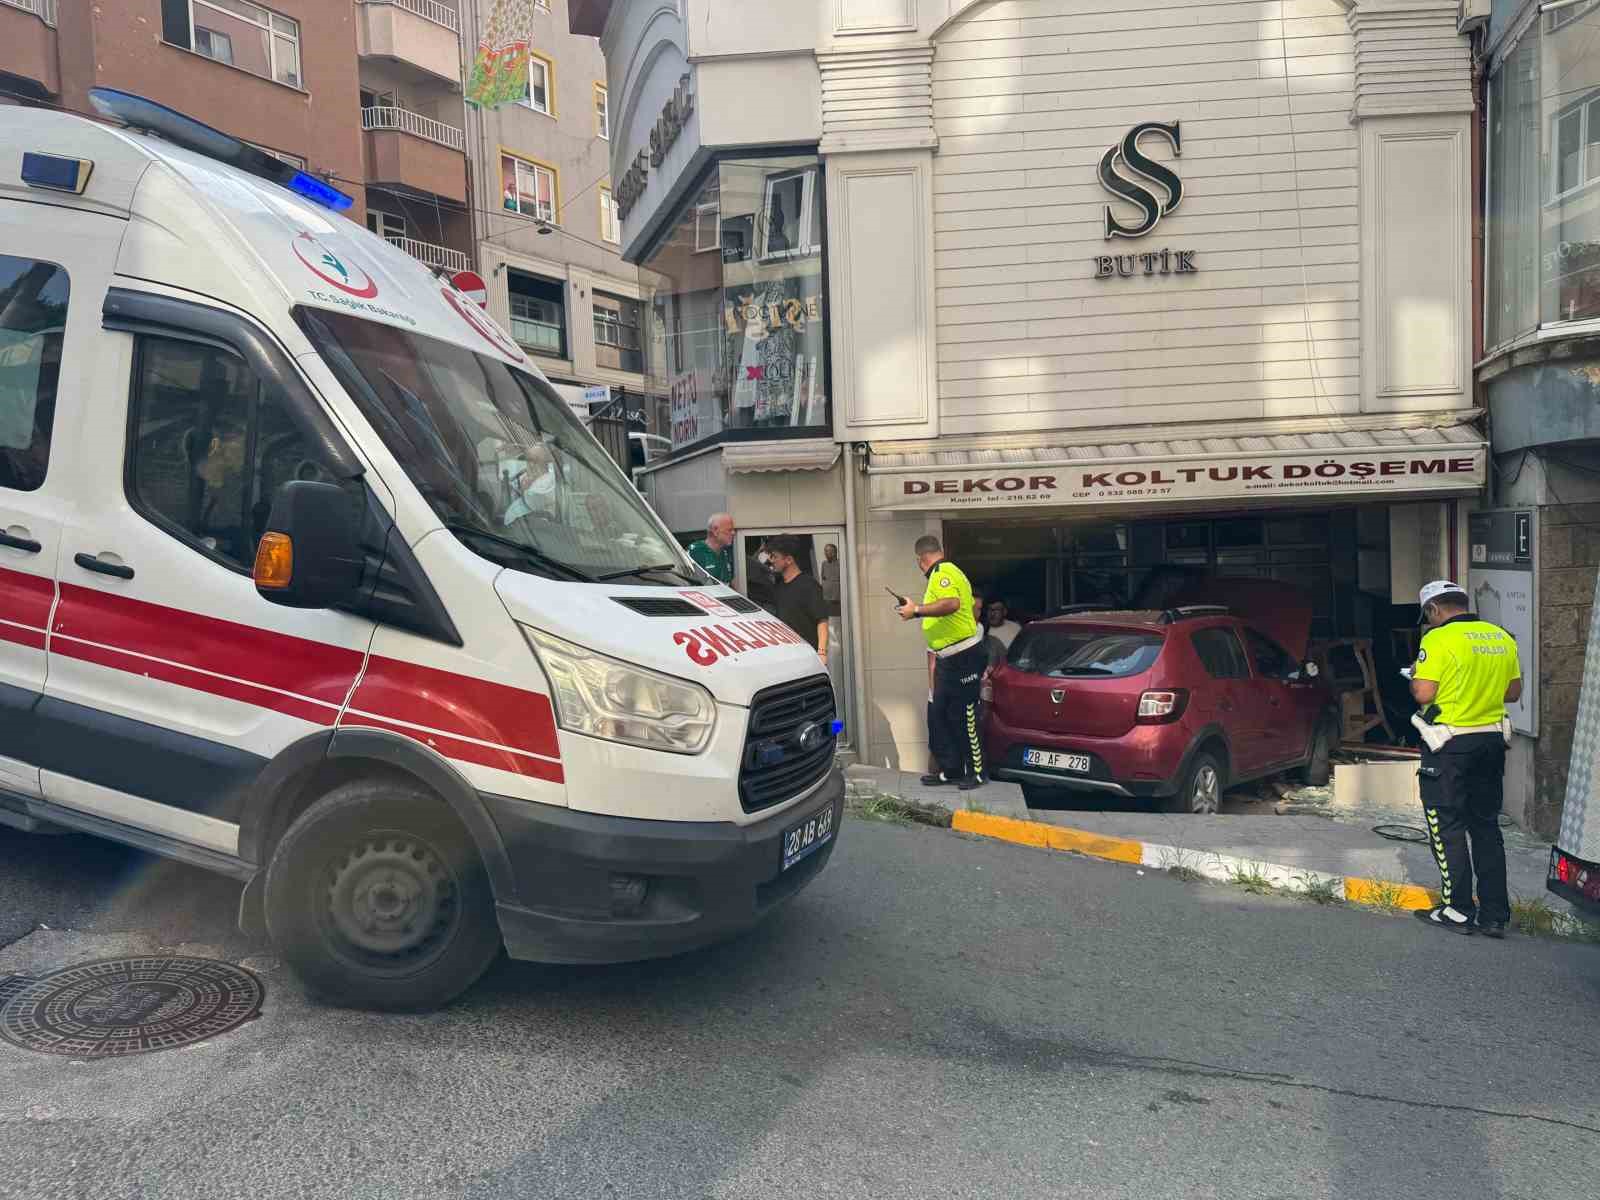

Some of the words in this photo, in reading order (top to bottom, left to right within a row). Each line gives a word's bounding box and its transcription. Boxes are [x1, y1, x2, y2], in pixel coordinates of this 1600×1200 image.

[1095, 249, 1198, 278] BUTİK
[903, 475, 1057, 495] DEKOR
[1082, 464, 1274, 488] KOLTUK
[1282, 457, 1475, 480] DÖŞEME
[1028, 751, 1040, 763] 28
[1047, 753, 1061, 766] AF
[1068, 756, 1088, 770] 278
[787, 828, 801, 857] 28
[801, 820, 816, 848] AB
